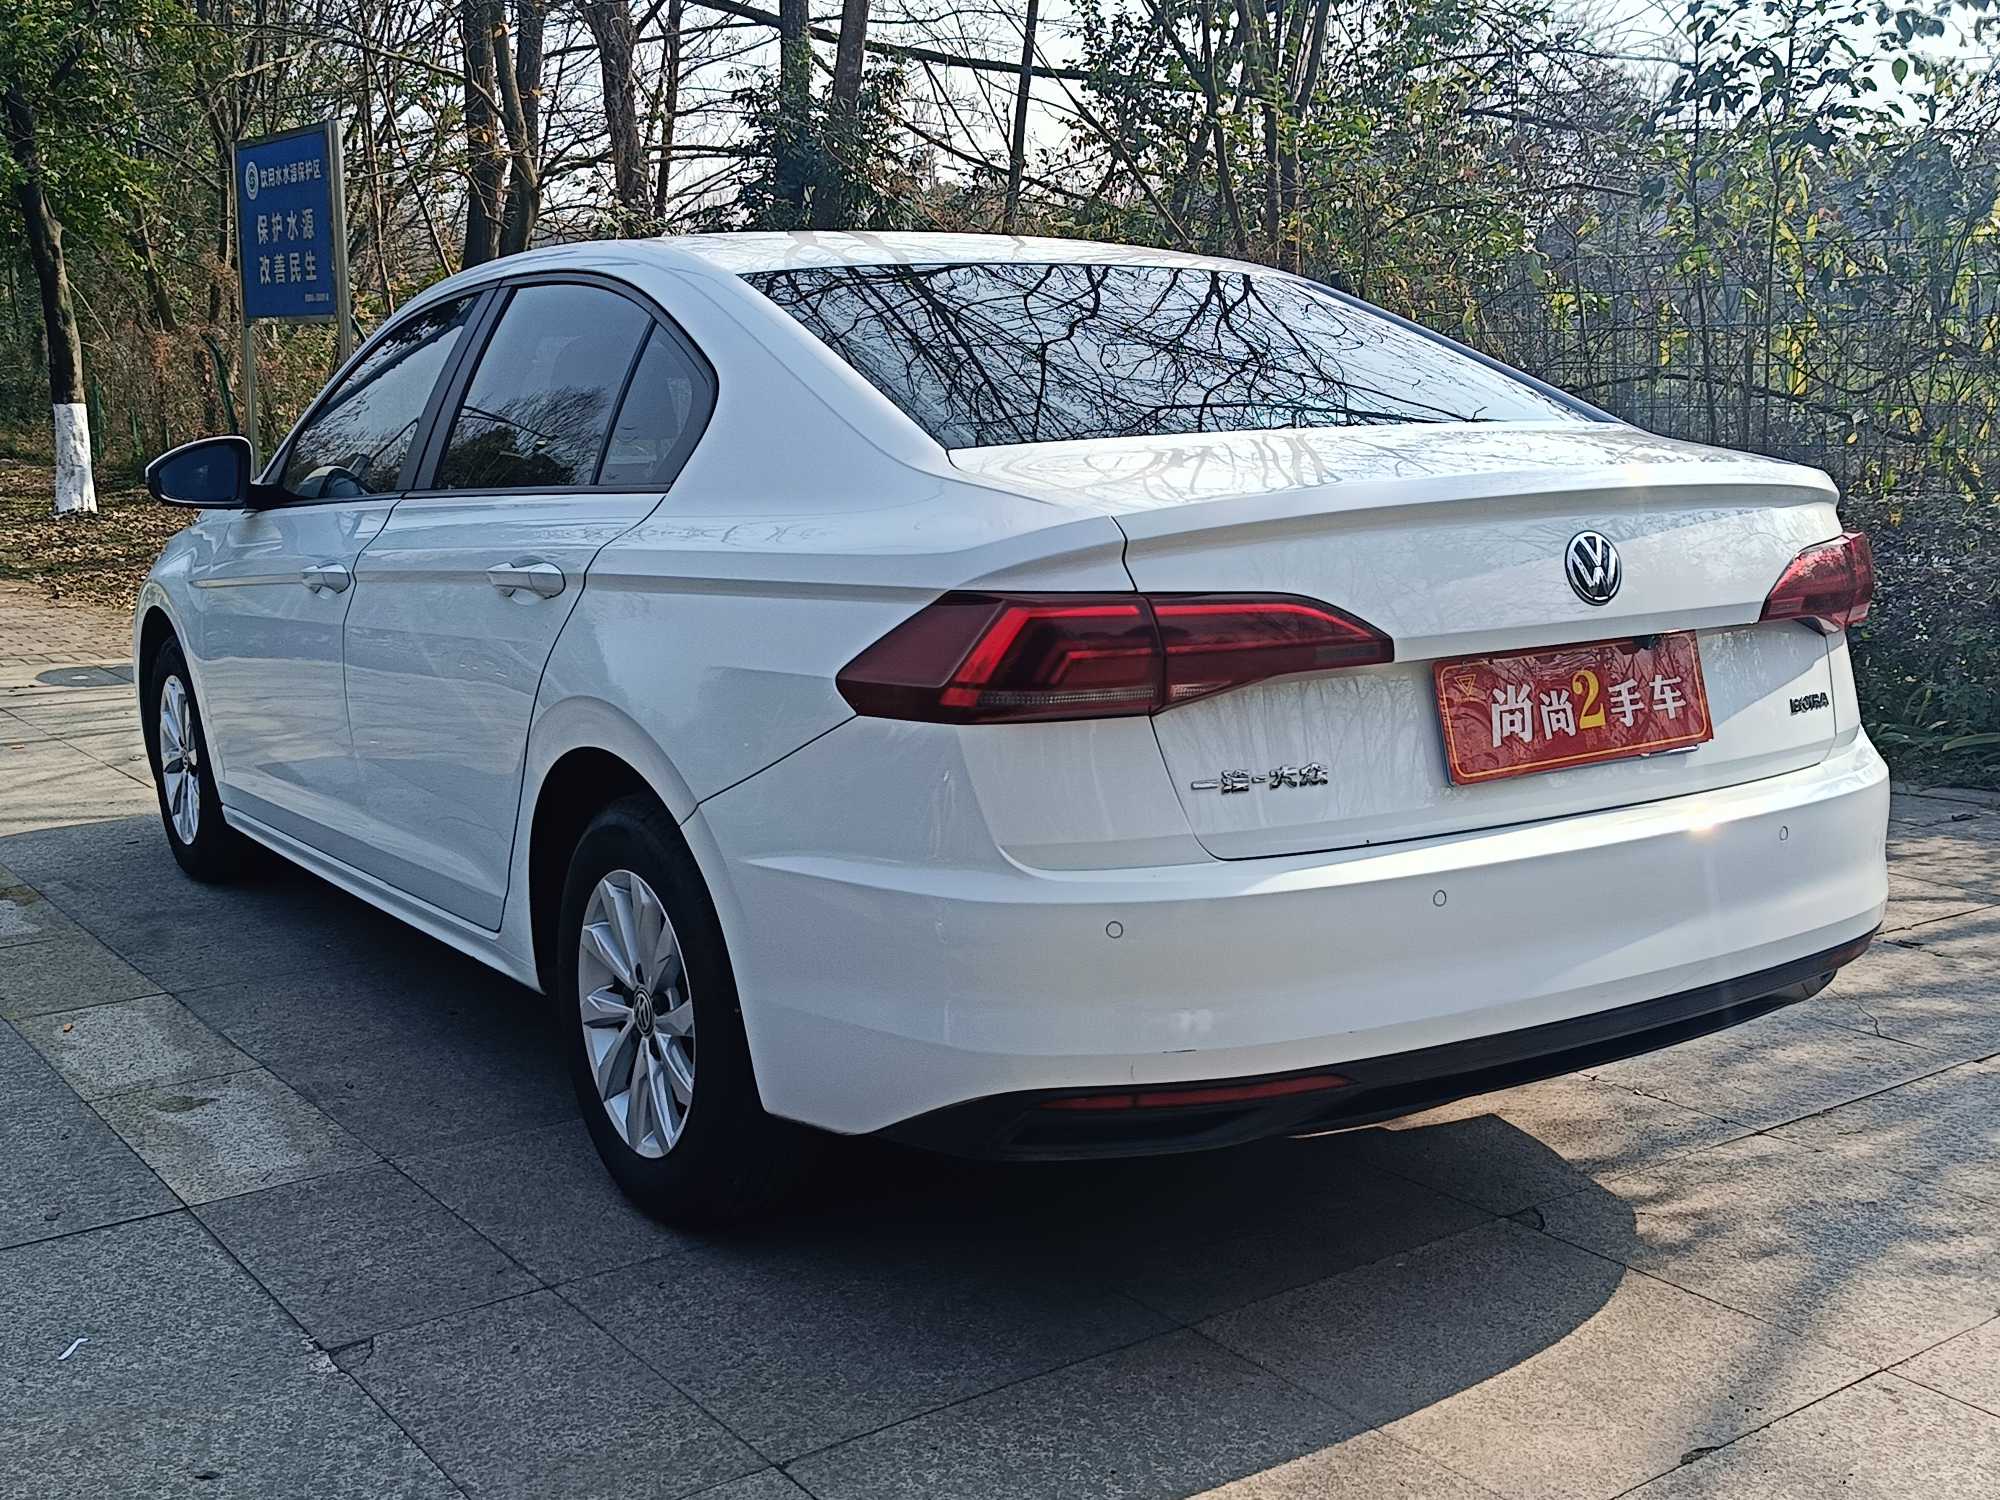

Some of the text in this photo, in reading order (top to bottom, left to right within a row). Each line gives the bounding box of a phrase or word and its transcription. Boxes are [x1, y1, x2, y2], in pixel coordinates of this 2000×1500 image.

[260, 158, 321, 188] 饮用水水源保护区
[257, 208, 315, 244] 保护水源
[259, 250, 317, 285] 改善民生
[1566, 531, 1621, 605] VW
[1490, 669, 1687, 748] 尚尚2手车
[1789, 691, 1829, 716] BORA
